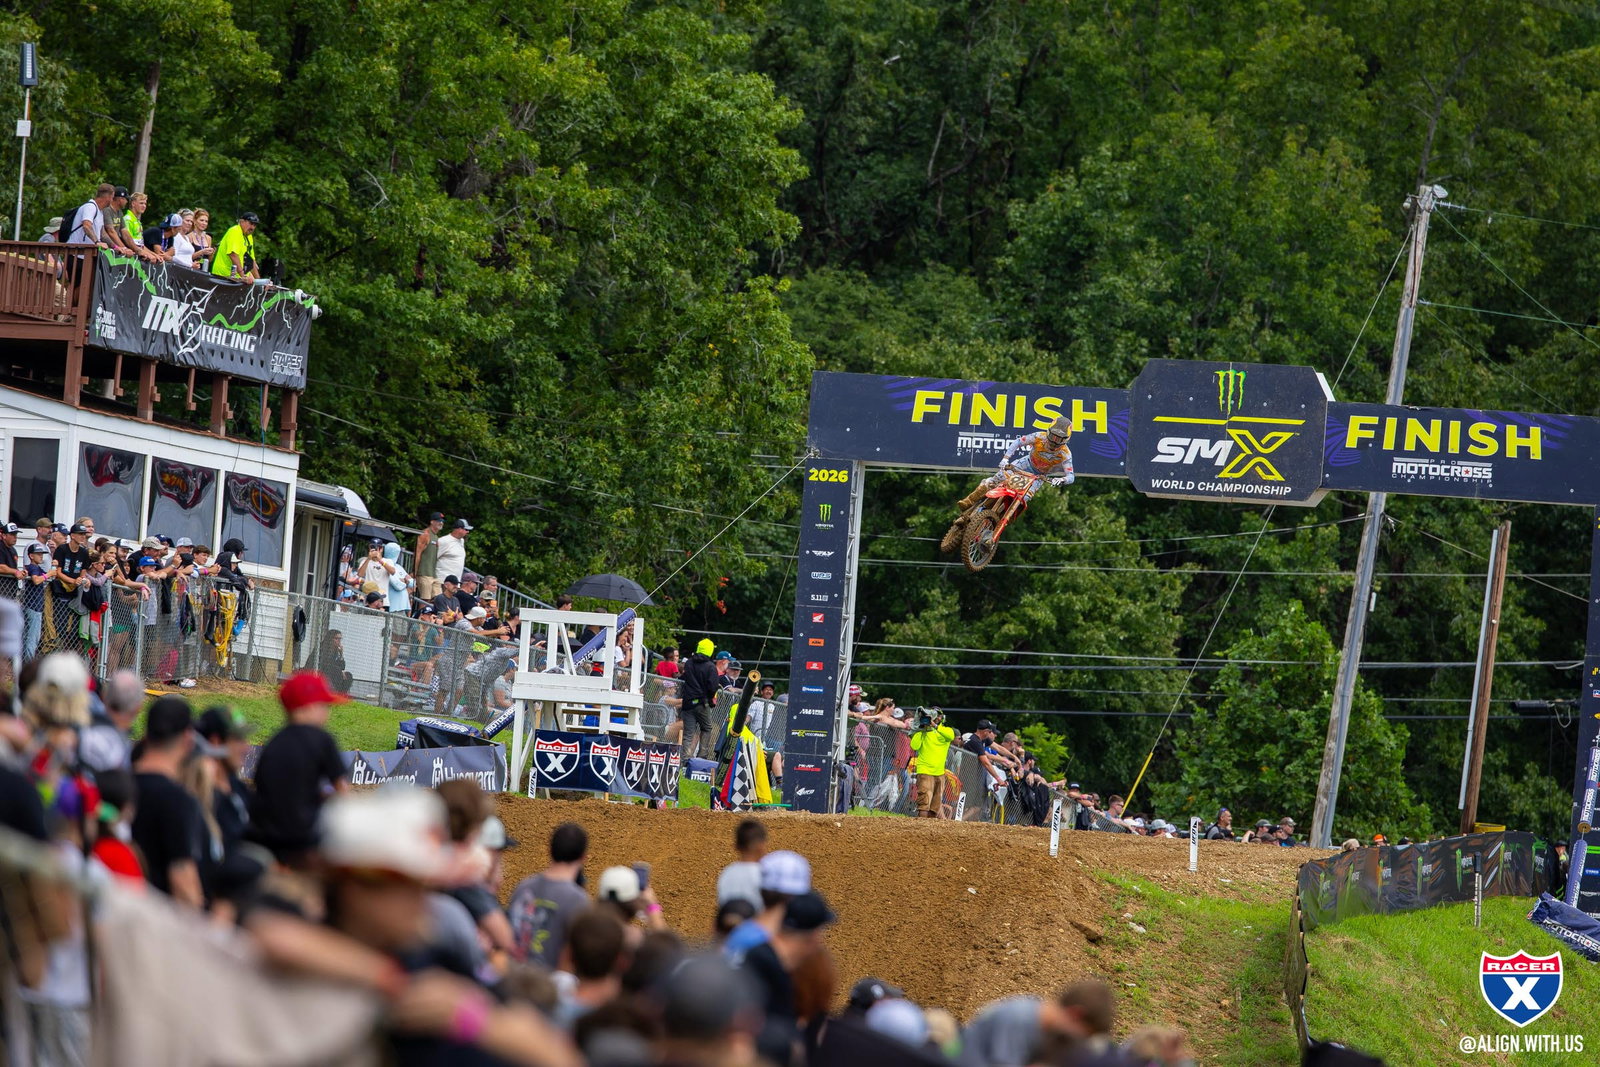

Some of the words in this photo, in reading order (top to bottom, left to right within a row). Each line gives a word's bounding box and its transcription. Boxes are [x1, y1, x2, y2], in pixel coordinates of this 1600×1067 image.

[201, 325, 257, 353] RACING
[911, 390, 1107, 434] FINISH
[1345, 415, 1542, 460] FINISH
[1151, 429, 1294, 481] SMX
[808, 469, 848, 482] 2026
[1392, 462, 1492, 478] MOTOCROSS
[1392, 474, 1492, 483] CHAMPIONSHIP
[1151, 479, 1195, 490] WORLD
[1198, 482, 1292, 495] CHAMPIONSHIP
[538, 744, 575, 752] RACER
[544, 752, 567, 773] X
[601, 756, 614, 777] X
[627, 762, 641, 781] X
[651, 764, 659, 783] X
[669, 766, 677, 785] X
